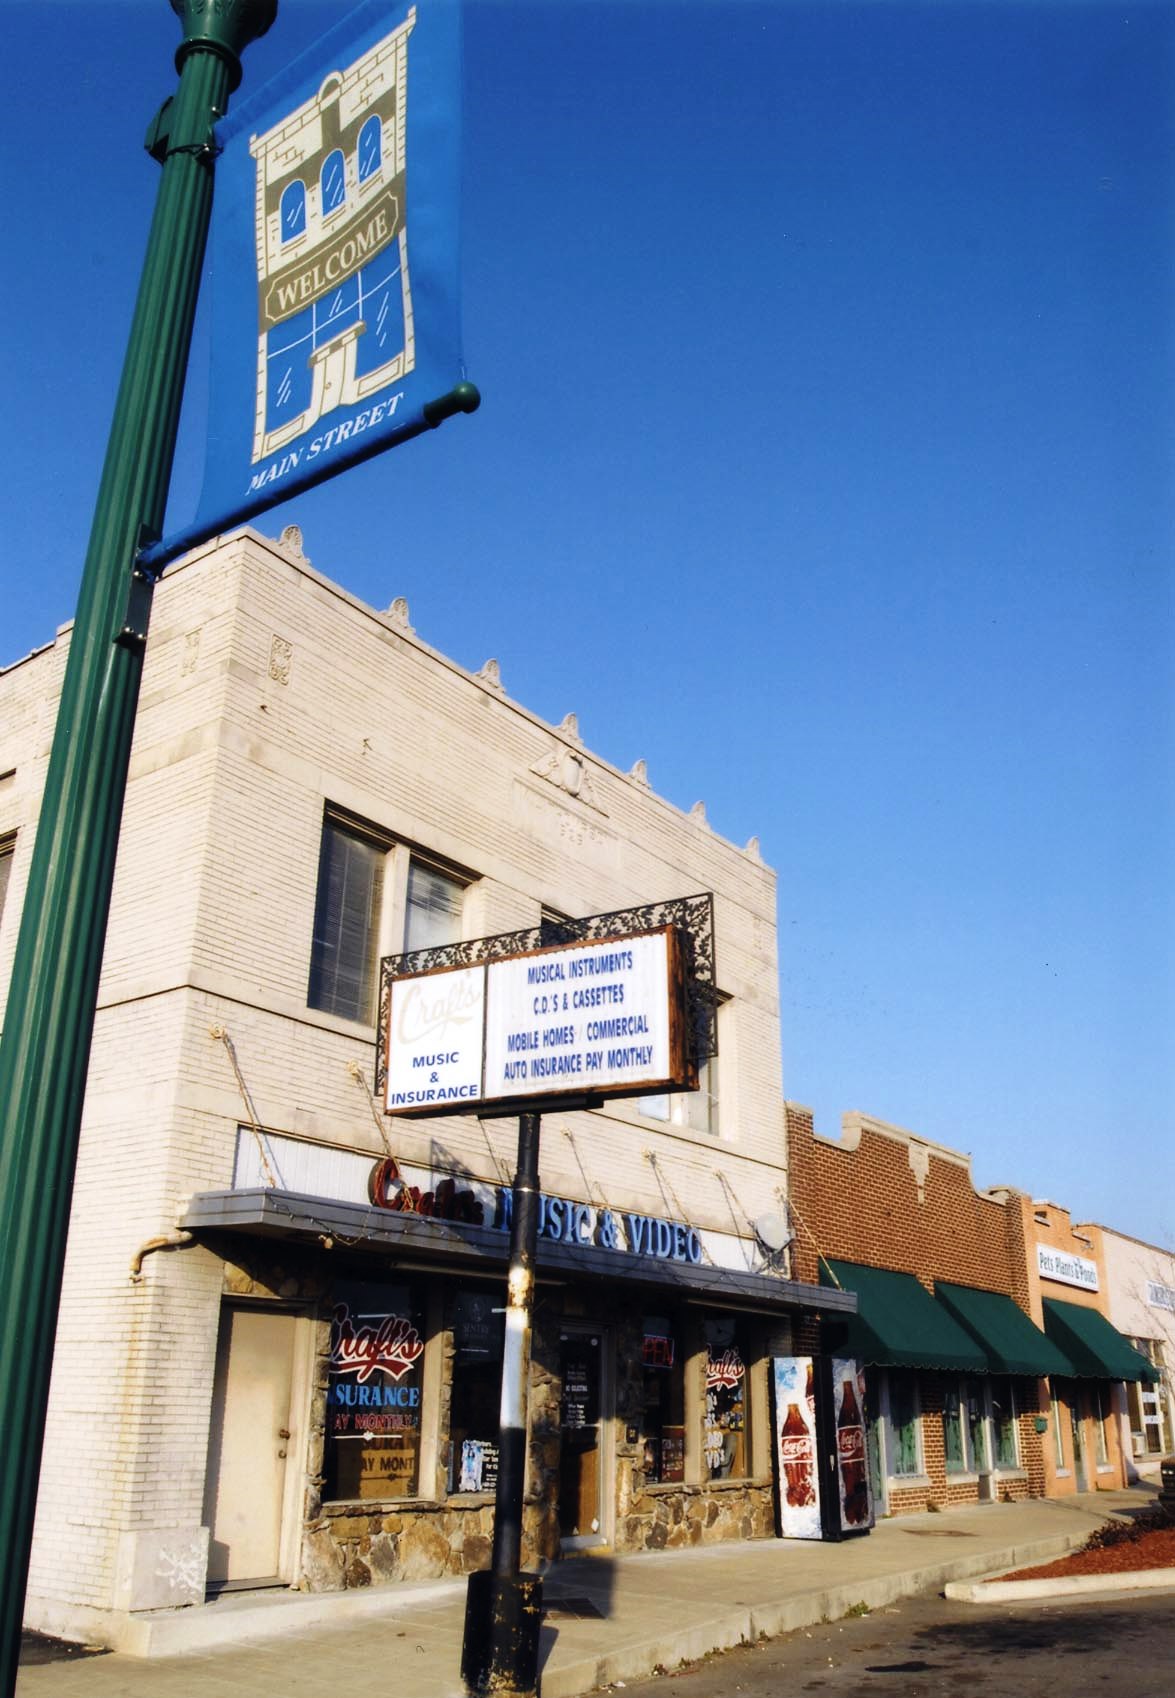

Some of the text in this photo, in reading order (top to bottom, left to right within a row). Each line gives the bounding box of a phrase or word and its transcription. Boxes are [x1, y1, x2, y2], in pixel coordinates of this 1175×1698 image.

[277, 208, 388, 311] WELCOME
[245, 391, 404, 497] MAIN STREET
[528, 950, 633, 985] MUSICAL INSTRUMENTS
[562, 992, 569, 1011] &
[573, 983, 625, 1009] CASSETTES
[507, 1030, 539, 1053] MOBILE
[542, 1025, 575, 1048] HOMES
[586, 1014, 649, 1041] COMMERCIAL
[412, 1051, 460, 1069] MUSIC
[429, 1071, 439, 1083] &
[504, 1045, 653, 1080] AUTO INSURANCE PAY MONTHLY
[391, 1084, 478, 1105] INSURANCE
[600, 1209, 618, 1250] &
[628, 1213, 703, 1264] VIDEO
[331, 1383, 420, 1407] SURANCE
